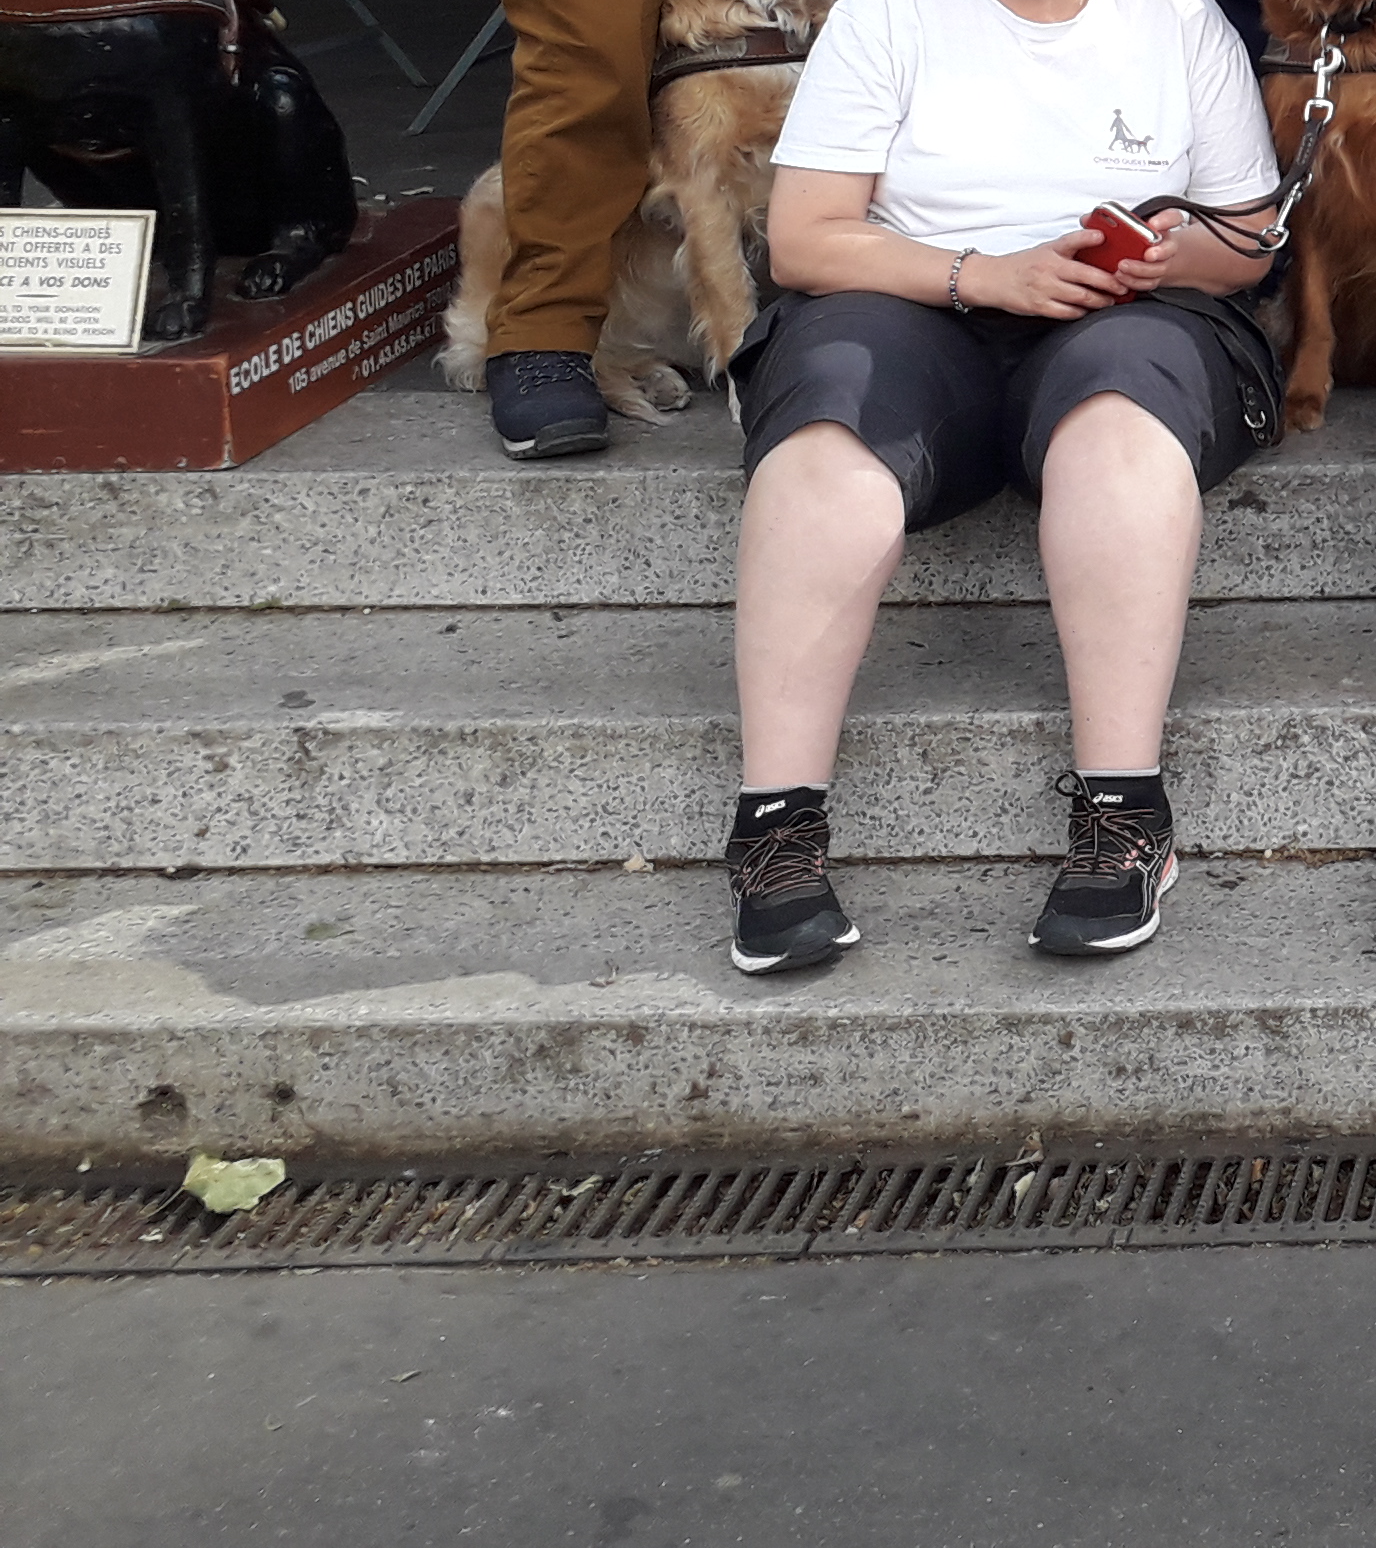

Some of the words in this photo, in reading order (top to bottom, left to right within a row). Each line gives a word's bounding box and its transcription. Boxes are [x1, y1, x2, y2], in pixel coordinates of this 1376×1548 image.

[13, 227, 111, 239] CHIENS-GUIDES
[0, 242, 16, 253] NT
[23, 242, 75, 253] OFFERTS
[82, 243, 91, 253] A
[99, 243, 122, 254] DES
[57, 258, 106, 269] VISUELS
[0, 276, 16, 287] CE
[21, 276, 30, 286] A
[39, 276, 66, 288] VOS
[70, 277, 112, 288] DONS
[229, 344, 280, 396] ECOLE
[281, 331, 303, 365] DE
[305, 301, 355, 350] CHIENS
[356, 274, 404, 321] GUIDES
[404, 262, 422, 293] DE
[424, 243, 458, 281] PARIS
[289, 368, 308, 395] 105
[310, 348, 347, 382] avenue
[348, 338, 361, 358] de
[362, 321, 388, 350] Saint
[388, 301, 425, 334] Maurice
